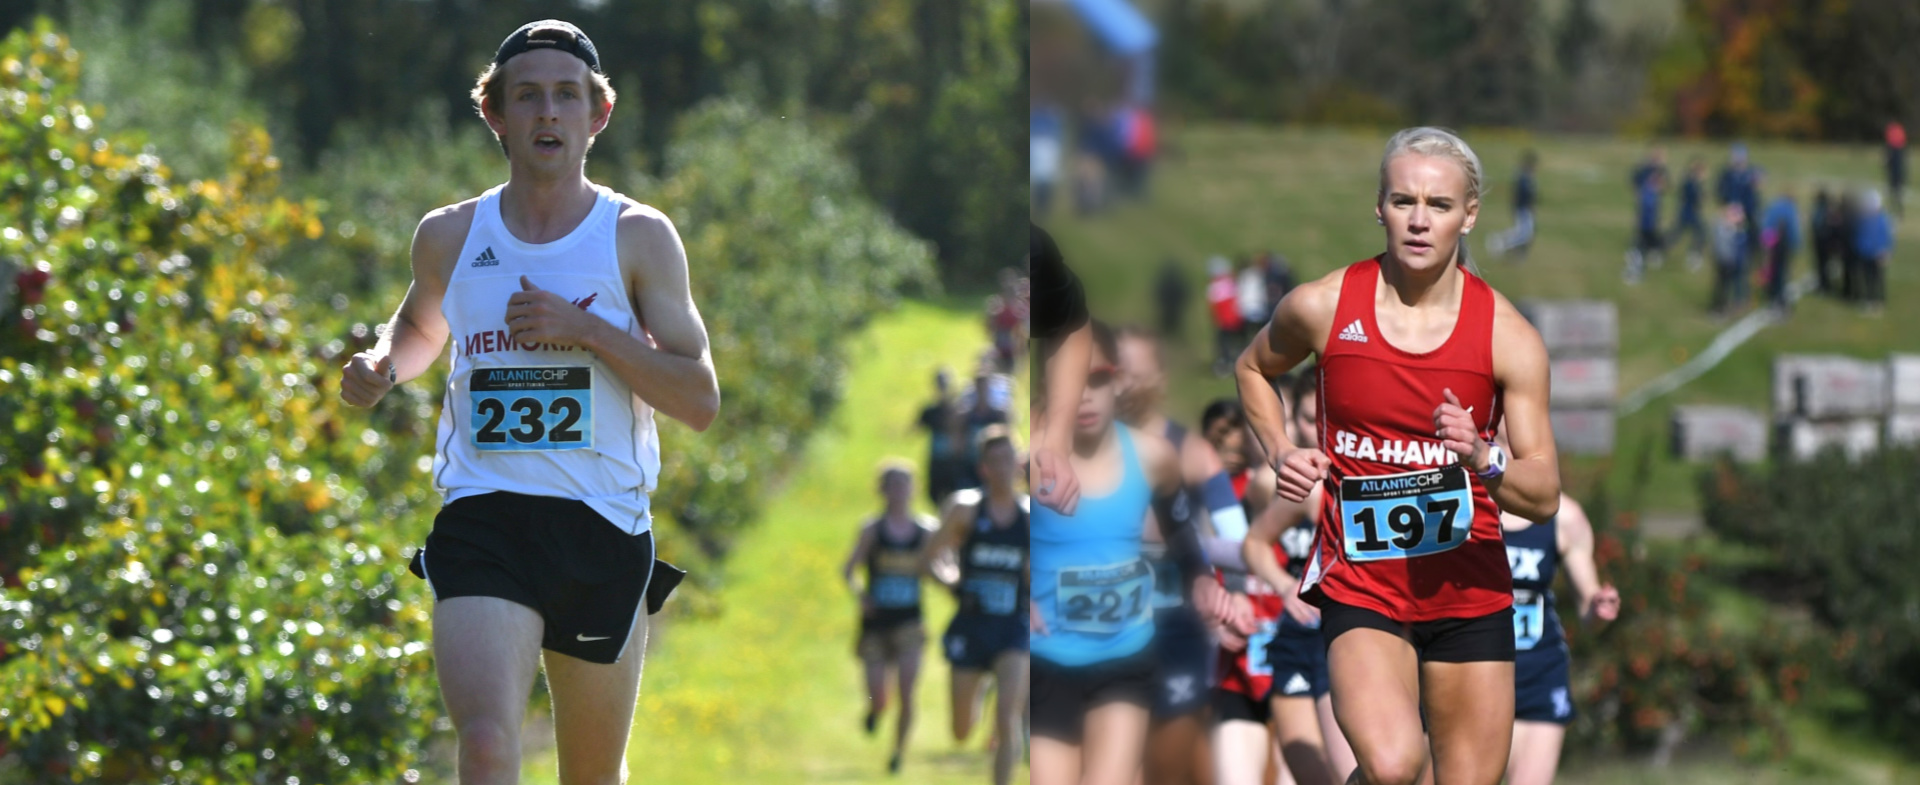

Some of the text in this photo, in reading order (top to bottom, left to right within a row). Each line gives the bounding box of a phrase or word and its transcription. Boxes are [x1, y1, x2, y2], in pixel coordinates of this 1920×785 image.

[471, 259, 500, 268] adidas
[1338, 332, 1369, 344] adidas
[476, 397, 583, 443] 232
[1352, 498, 1460, 552] 197
[1066, 585, 1143, 622] 221
